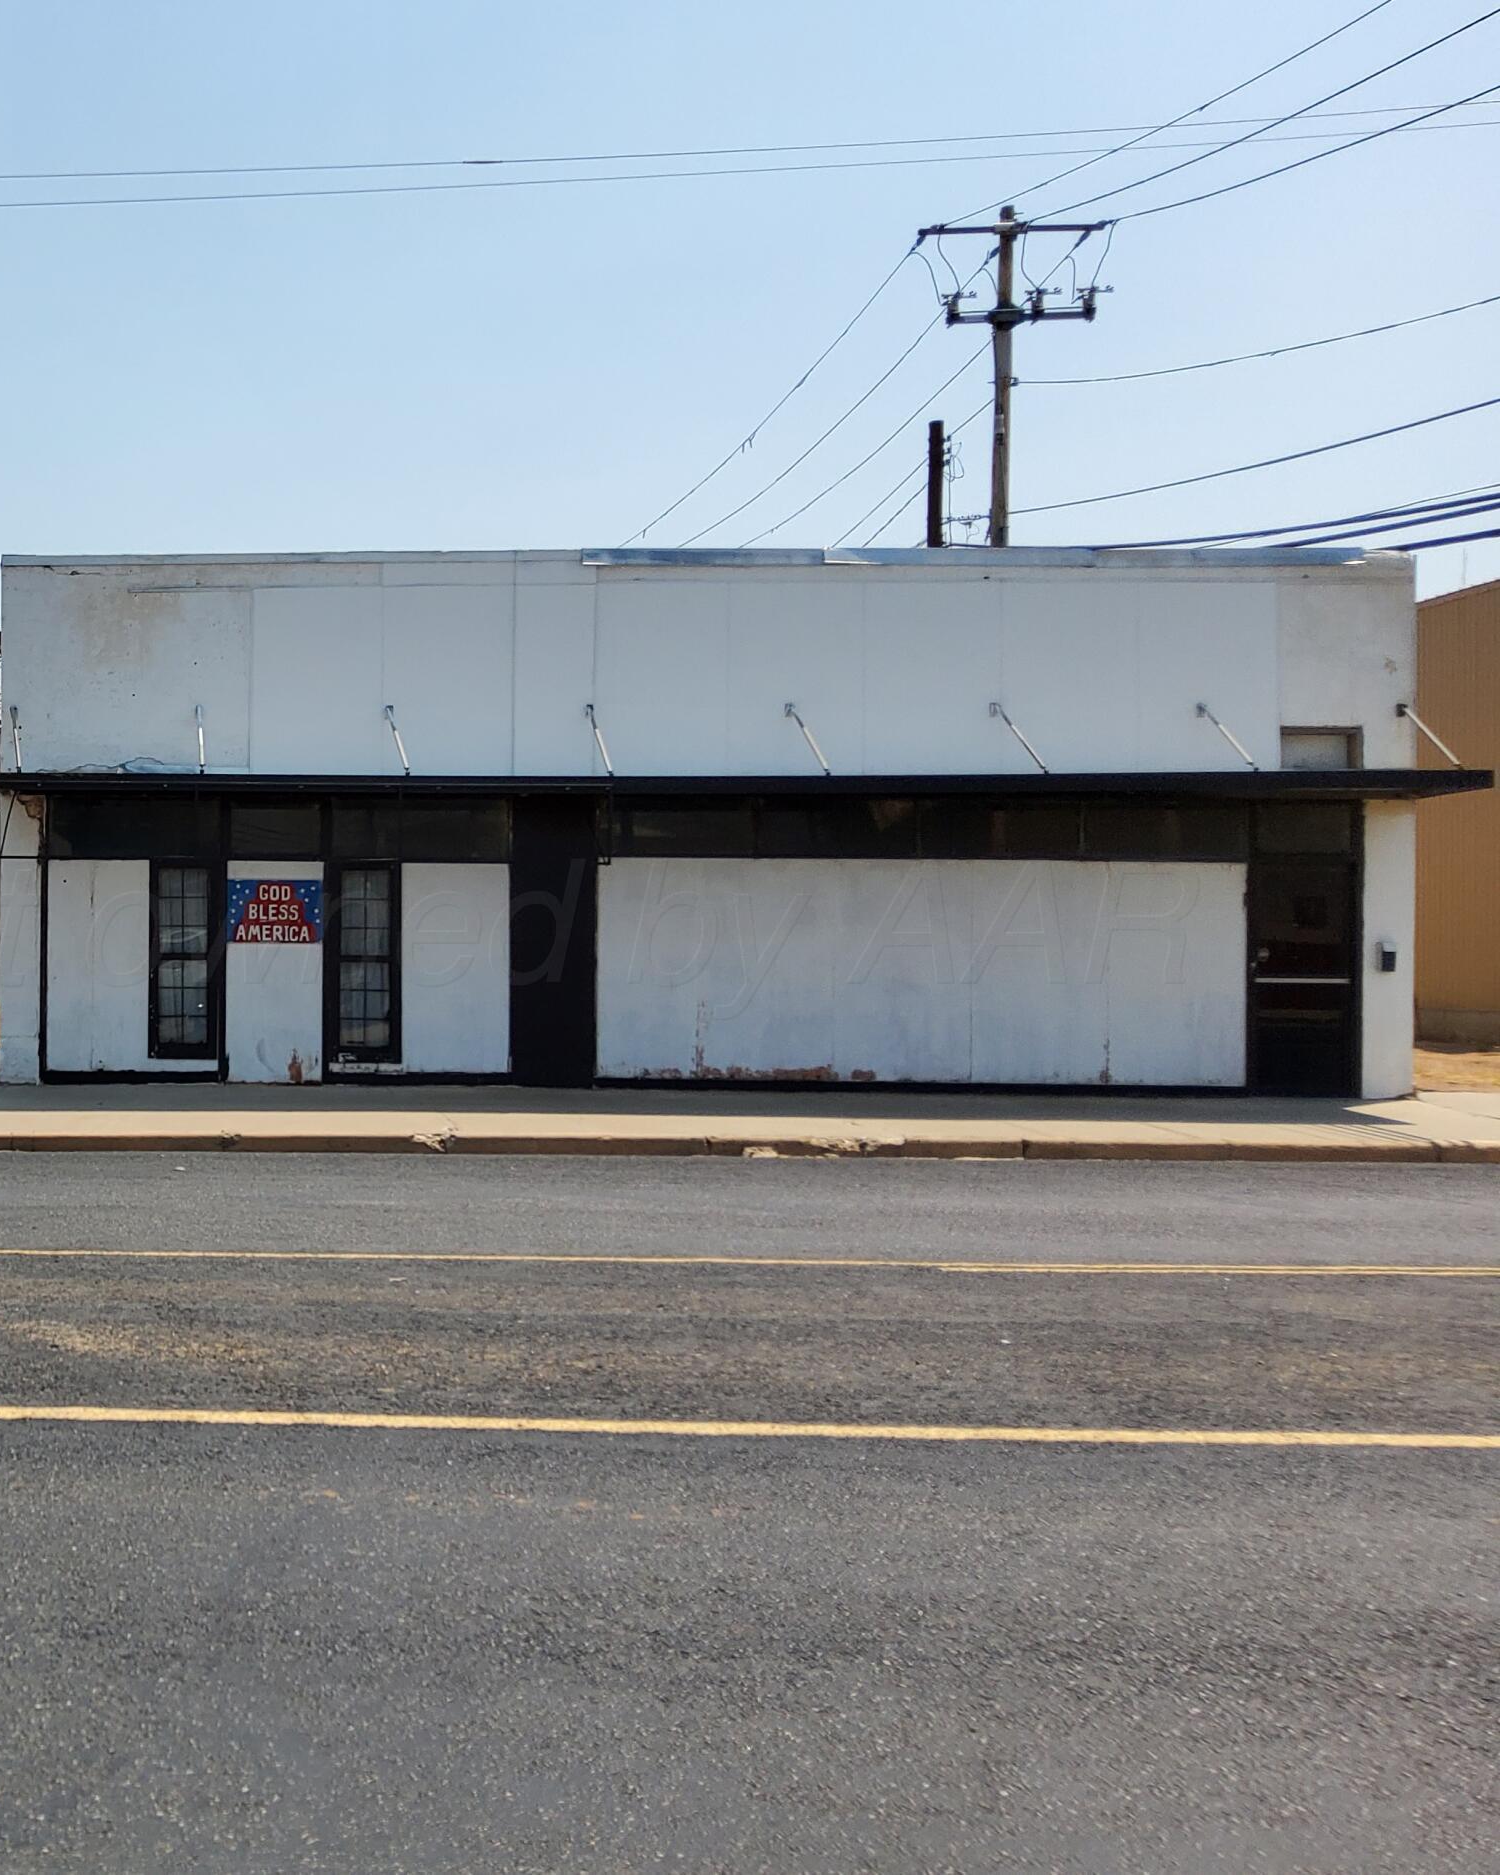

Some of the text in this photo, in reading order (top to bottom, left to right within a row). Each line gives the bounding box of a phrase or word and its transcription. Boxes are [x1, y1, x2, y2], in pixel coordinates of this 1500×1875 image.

[259, 885, 291, 901] GOD
[249, 904, 299, 920] BLESS
[236, 924, 309, 942] AMERICA
